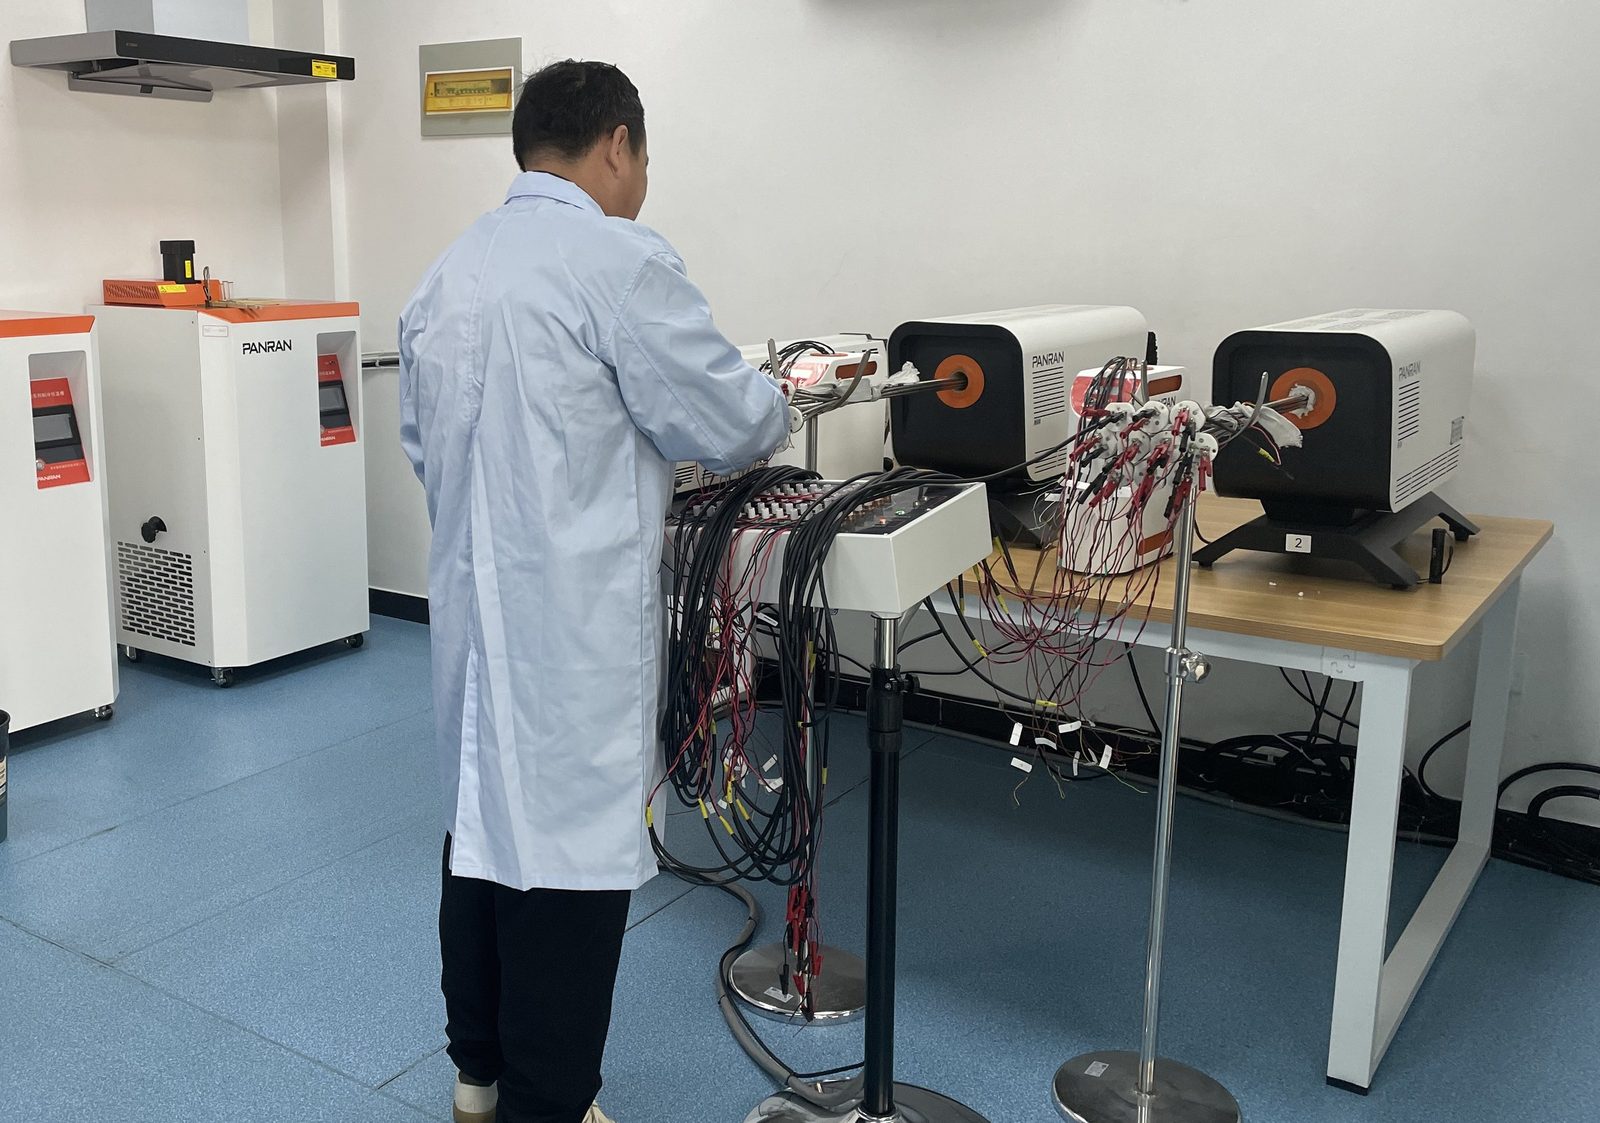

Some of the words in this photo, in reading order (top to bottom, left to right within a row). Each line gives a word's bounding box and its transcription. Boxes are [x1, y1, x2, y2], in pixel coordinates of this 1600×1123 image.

[242, 339, 292, 355] PANRAN
[1032, 351, 1065, 368] PANRAN
[1294, 537, 1303, 549] 2
